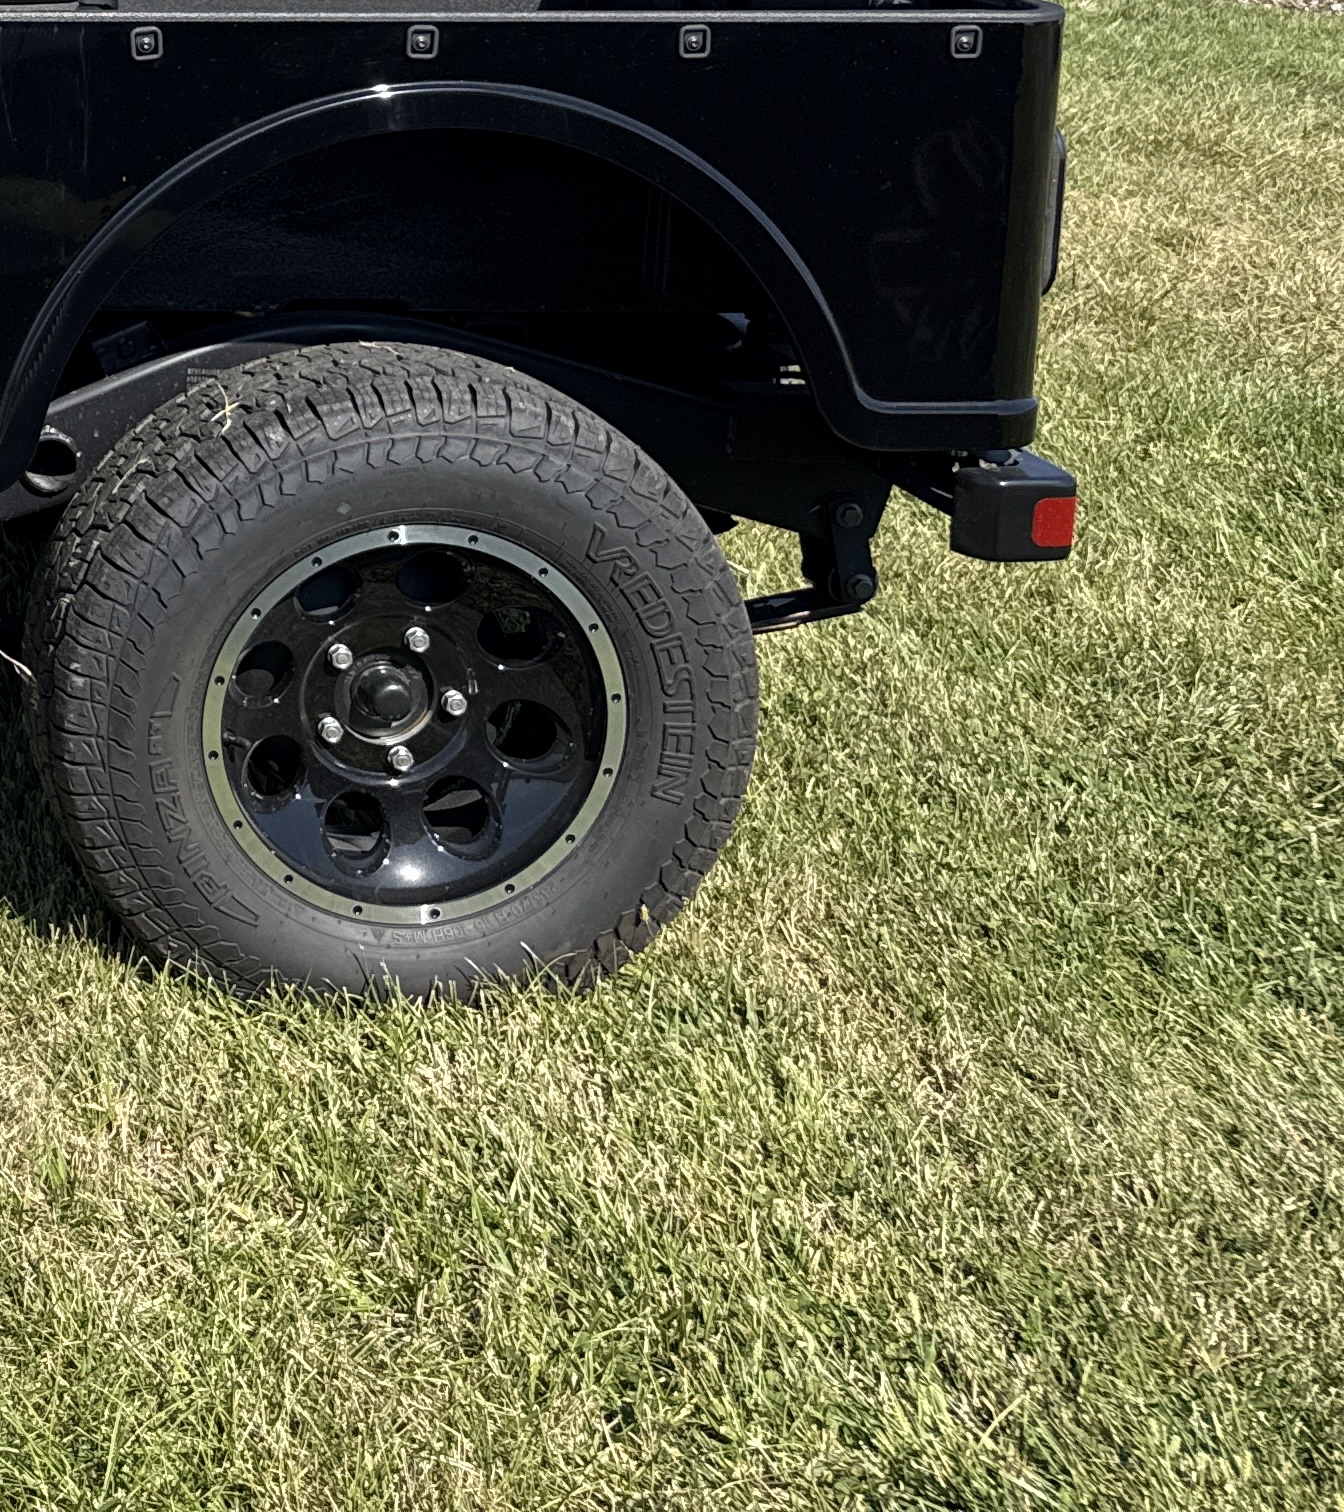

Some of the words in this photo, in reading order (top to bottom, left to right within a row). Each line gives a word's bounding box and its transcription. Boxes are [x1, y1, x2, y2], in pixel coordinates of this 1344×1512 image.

[585, 521, 697, 805] VREDESTEIN
[149, 758, 228, 907] PINZA
[392, 929, 428, 945] M+S
